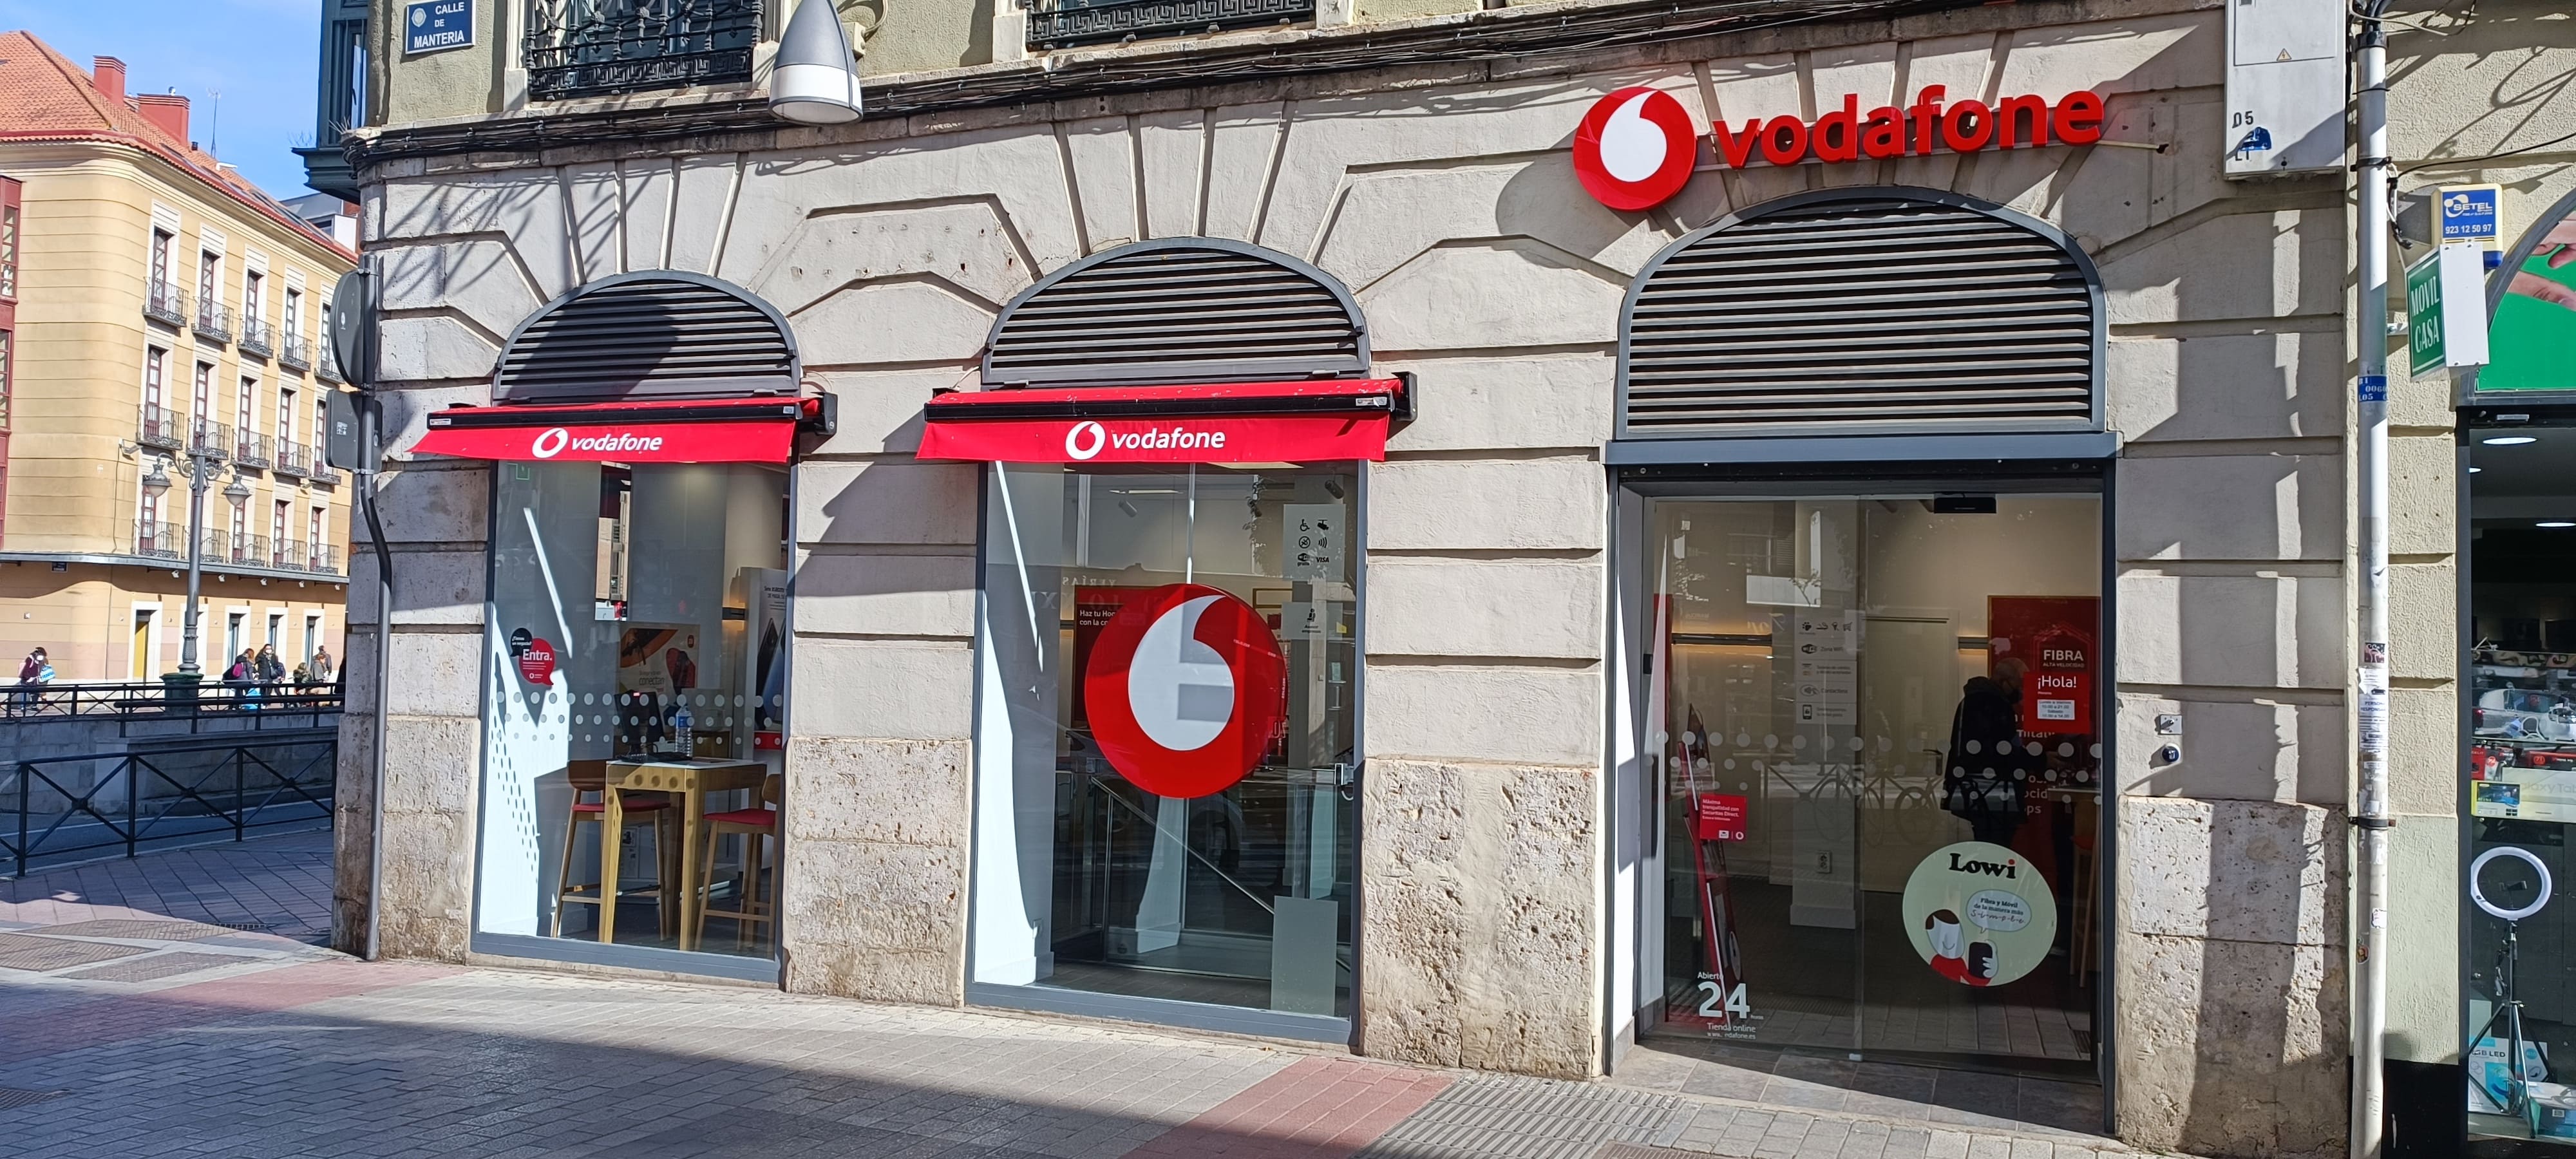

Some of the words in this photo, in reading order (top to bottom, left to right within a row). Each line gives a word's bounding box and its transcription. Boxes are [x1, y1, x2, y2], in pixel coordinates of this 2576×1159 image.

[435, 2, 464, 14] CALLE
[435, 19, 444, 27] DE
[414, 30, 464, 48] MANTERIA
[1711, 84, 2105, 169] vodafone
[2454, 202, 2493, 211] SETEL
[2445, 225, 2459, 234] 923
[2472, 224, 2481, 232] 50
[2483, 223, 2492, 232] 97
[2410, 276, 2439, 317] MOVIL
[2415, 316, 2439, 353] CASA
[571, 433, 663, 451] vodafone
[1111, 427, 1226, 449] vodafone
[522, 648, 553, 661] Entra.
[2043, 650, 2084, 661] FIBRA
[2038, 675, 2077, 690] ¡Hola!
[1949, 853, 2016, 879] Lowi
[1698, 981, 1750, 1019] 24
[1707, 1022, 1731, 1031] Tienda
